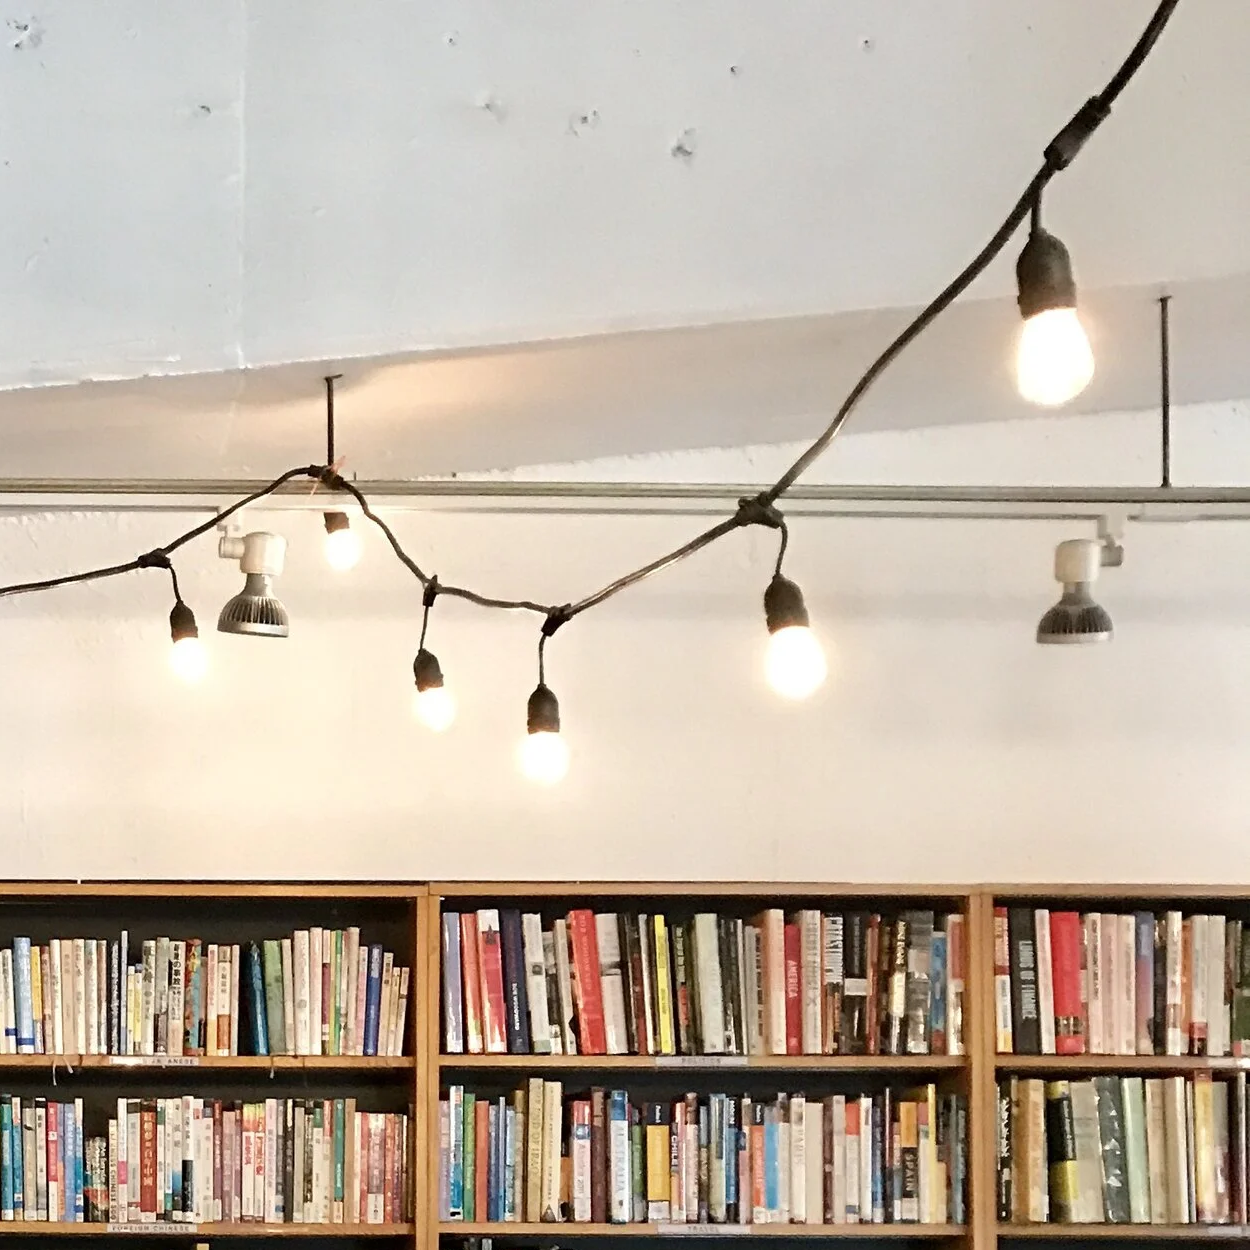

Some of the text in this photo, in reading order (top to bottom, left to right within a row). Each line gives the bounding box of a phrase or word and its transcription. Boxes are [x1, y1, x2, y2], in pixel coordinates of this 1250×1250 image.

[786, 960, 798, 999] AMERICA
[1020, 971, 1035, 981] OF
[1021, 985, 1037, 1019] FINANCE
[615, 1125, 628, 1193] AUSTRALIA
[905, 1154, 916, 1191] SPAIN
